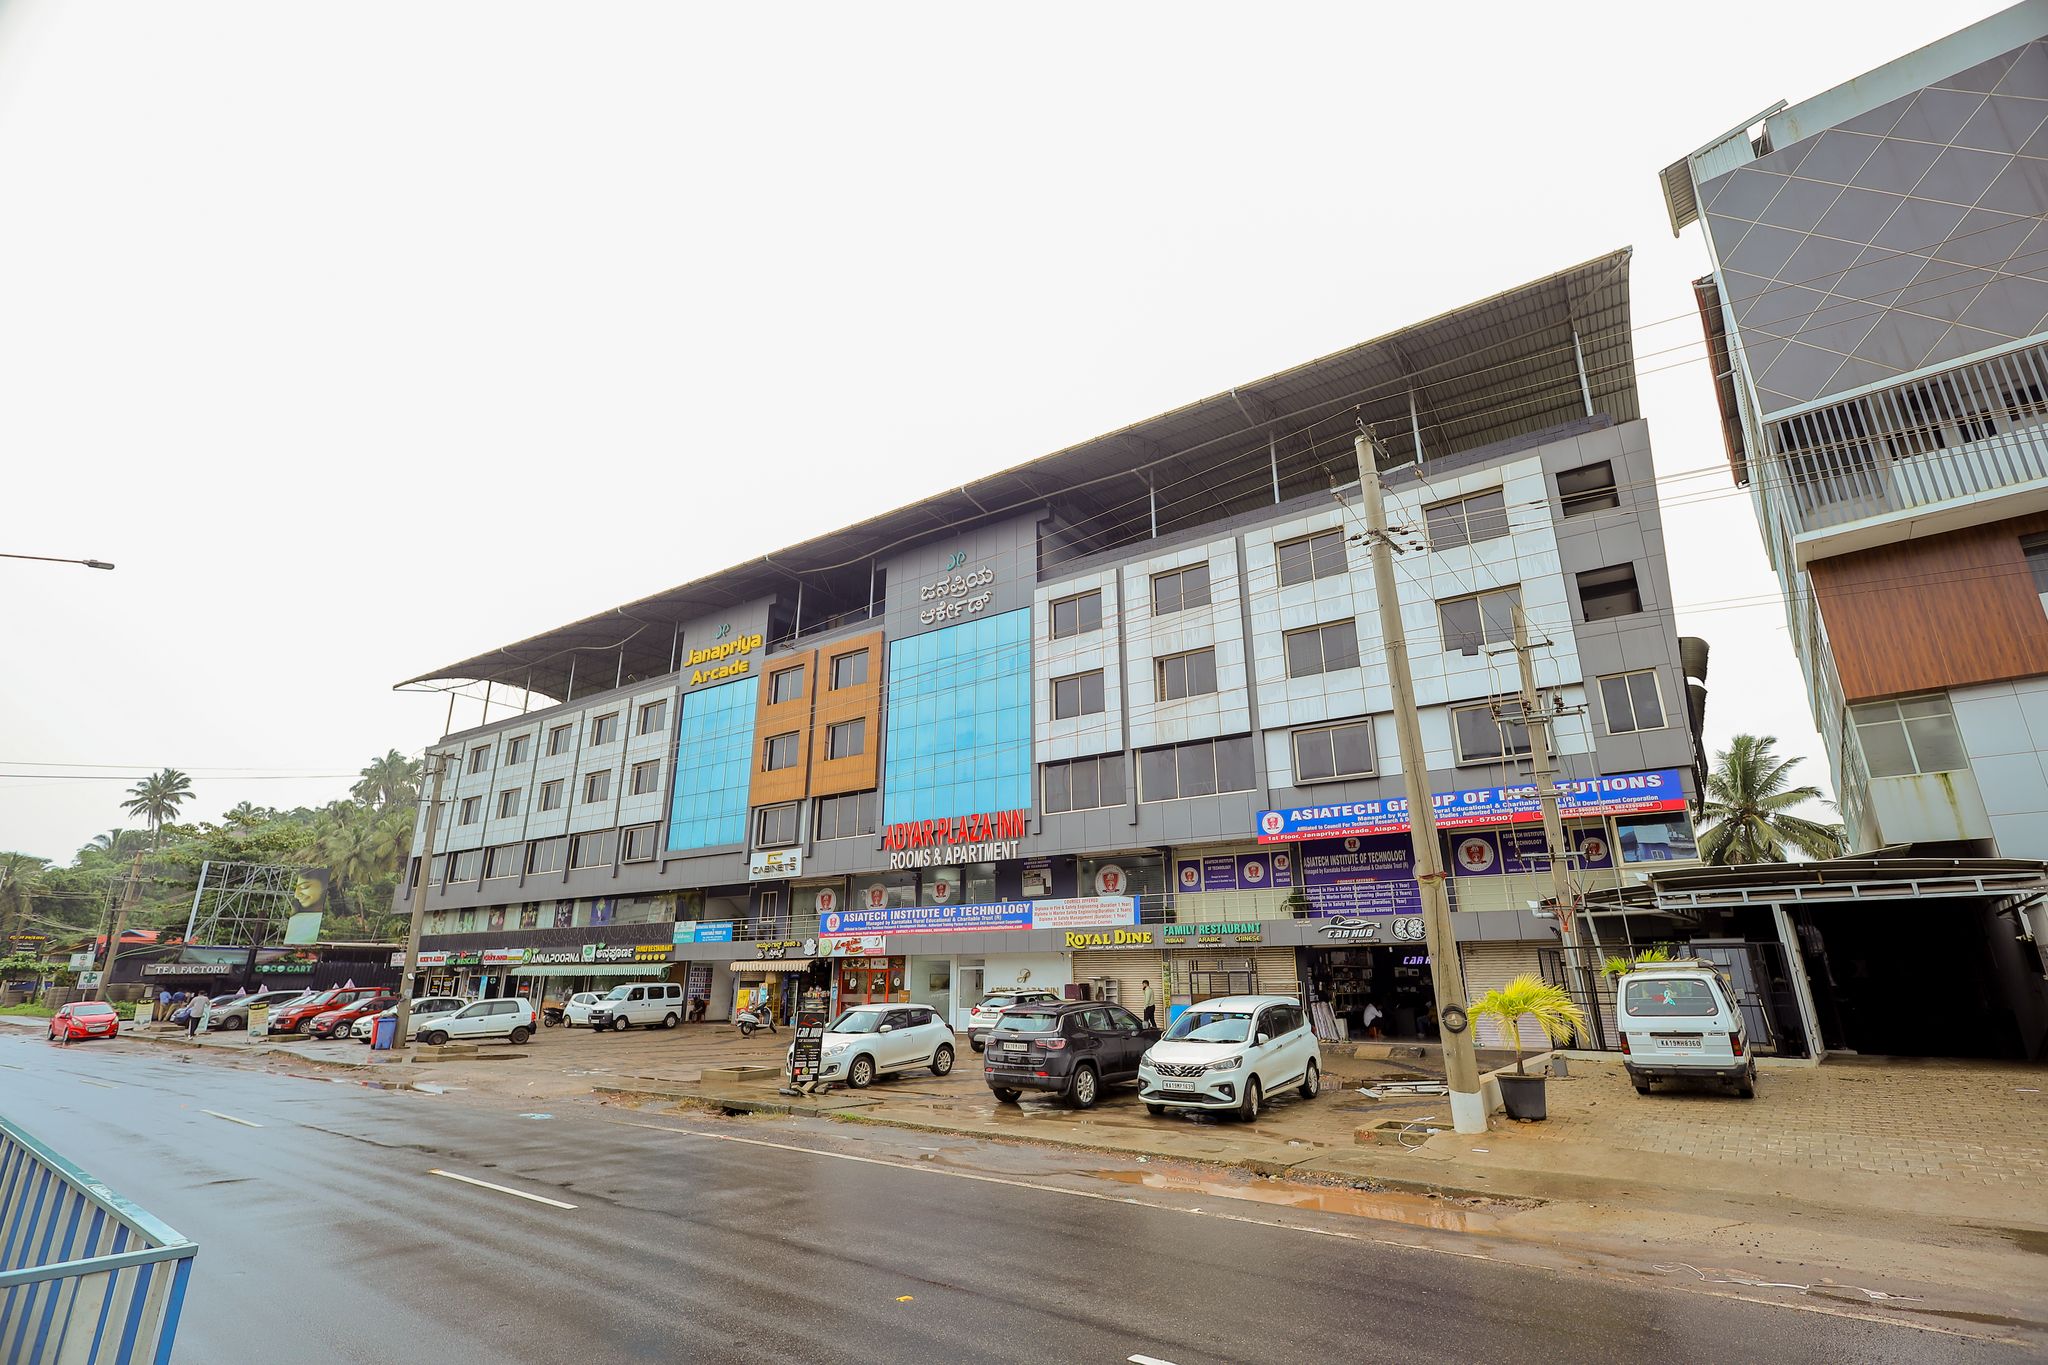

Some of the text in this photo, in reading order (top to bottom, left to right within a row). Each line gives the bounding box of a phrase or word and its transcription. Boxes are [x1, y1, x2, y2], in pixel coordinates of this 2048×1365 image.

[684, 634, 763, 667] Janapriya
[690, 660, 749, 686] Arcade
[1290, 802, 1380, 821] ASIATECH
[1386, 794, 1456, 811] GRUP
[1463, 790, 1491, 804] OF
[1622, 795, 1659, 803] Corporation
[1357, 814, 1386, 822] Managed
[1452, 804, 1492, 812] Educational
[1502, 800, 1540, 808] Charitable
[884, 808, 1025, 852] ADYAR PLAZA INN
[1303, 830, 1340, 838] Janapriya
[1435, 818, 1473, 827] angaluru
[890, 848, 931, 870] ROOMS
[933, 847, 942, 866] &
[944, 840, 1019, 865] APARTMENT
[1304, 849, 1406, 867] ASIATECH INSTITUTE OF TECHNOLOGY
[752, 863, 796, 875] CABINETS
[843, 903, 1030, 923] ASIATECH INSTITUTE OF TECHNOLOGY
[1163, 922, 1261, 936] FAMILY RESTAURANT
[1351, 928, 1374, 938] HUB
[530, 953, 580, 963] ANNAPOORNA
[155, 965, 226, 974] TEA FACTORY
[255, 965, 312, 973] COCO CART
